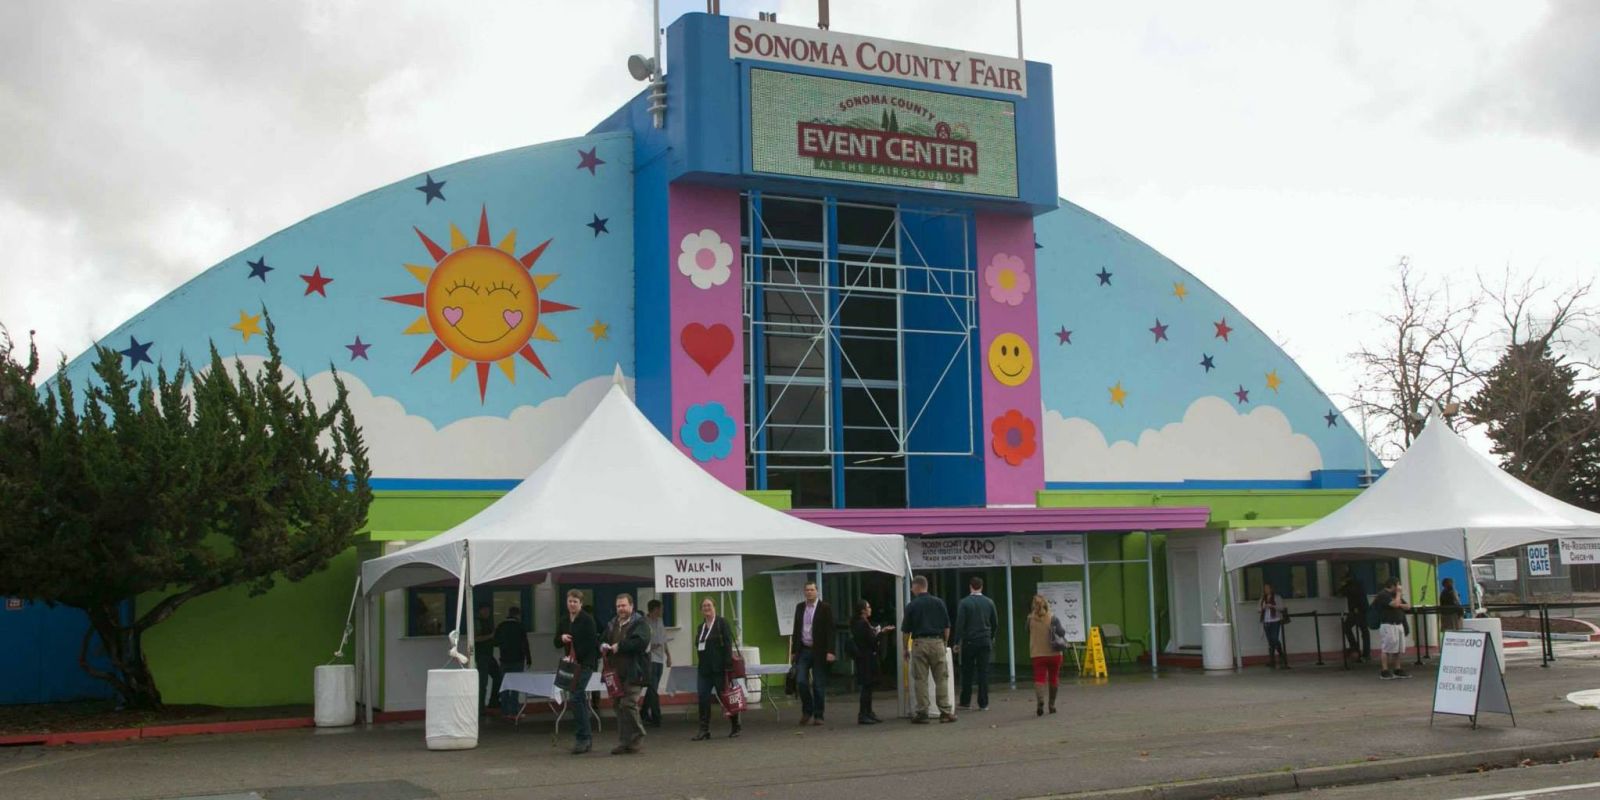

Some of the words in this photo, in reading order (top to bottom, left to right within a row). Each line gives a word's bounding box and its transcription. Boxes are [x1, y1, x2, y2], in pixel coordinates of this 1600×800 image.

[734, 24, 849, 68] SONOMA
[855, 41, 960, 83] COUNTY
[969, 57, 1022, 91] FAIR
[839, 94, 888, 112] SONOMA
[890, 97, 936, 122] COUNTY
[803, 128, 882, 159] EVENT
[885, 138, 974, 169] CENTER
[819, 159, 833, 169] AT
[841, 161, 864, 173] THE
[871, 165, 961, 182] FAIRGROUNDS
[963, 539, 995, 554] EXPO
[1529, 547, 1548, 559] GOLF
[675, 559, 722, 573] WALK-IN
[1531, 560, 1549, 571] GATE
[665, 575, 733, 588] REGISTRATION
[1443, 665, 1477, 675] REGISTRATION
